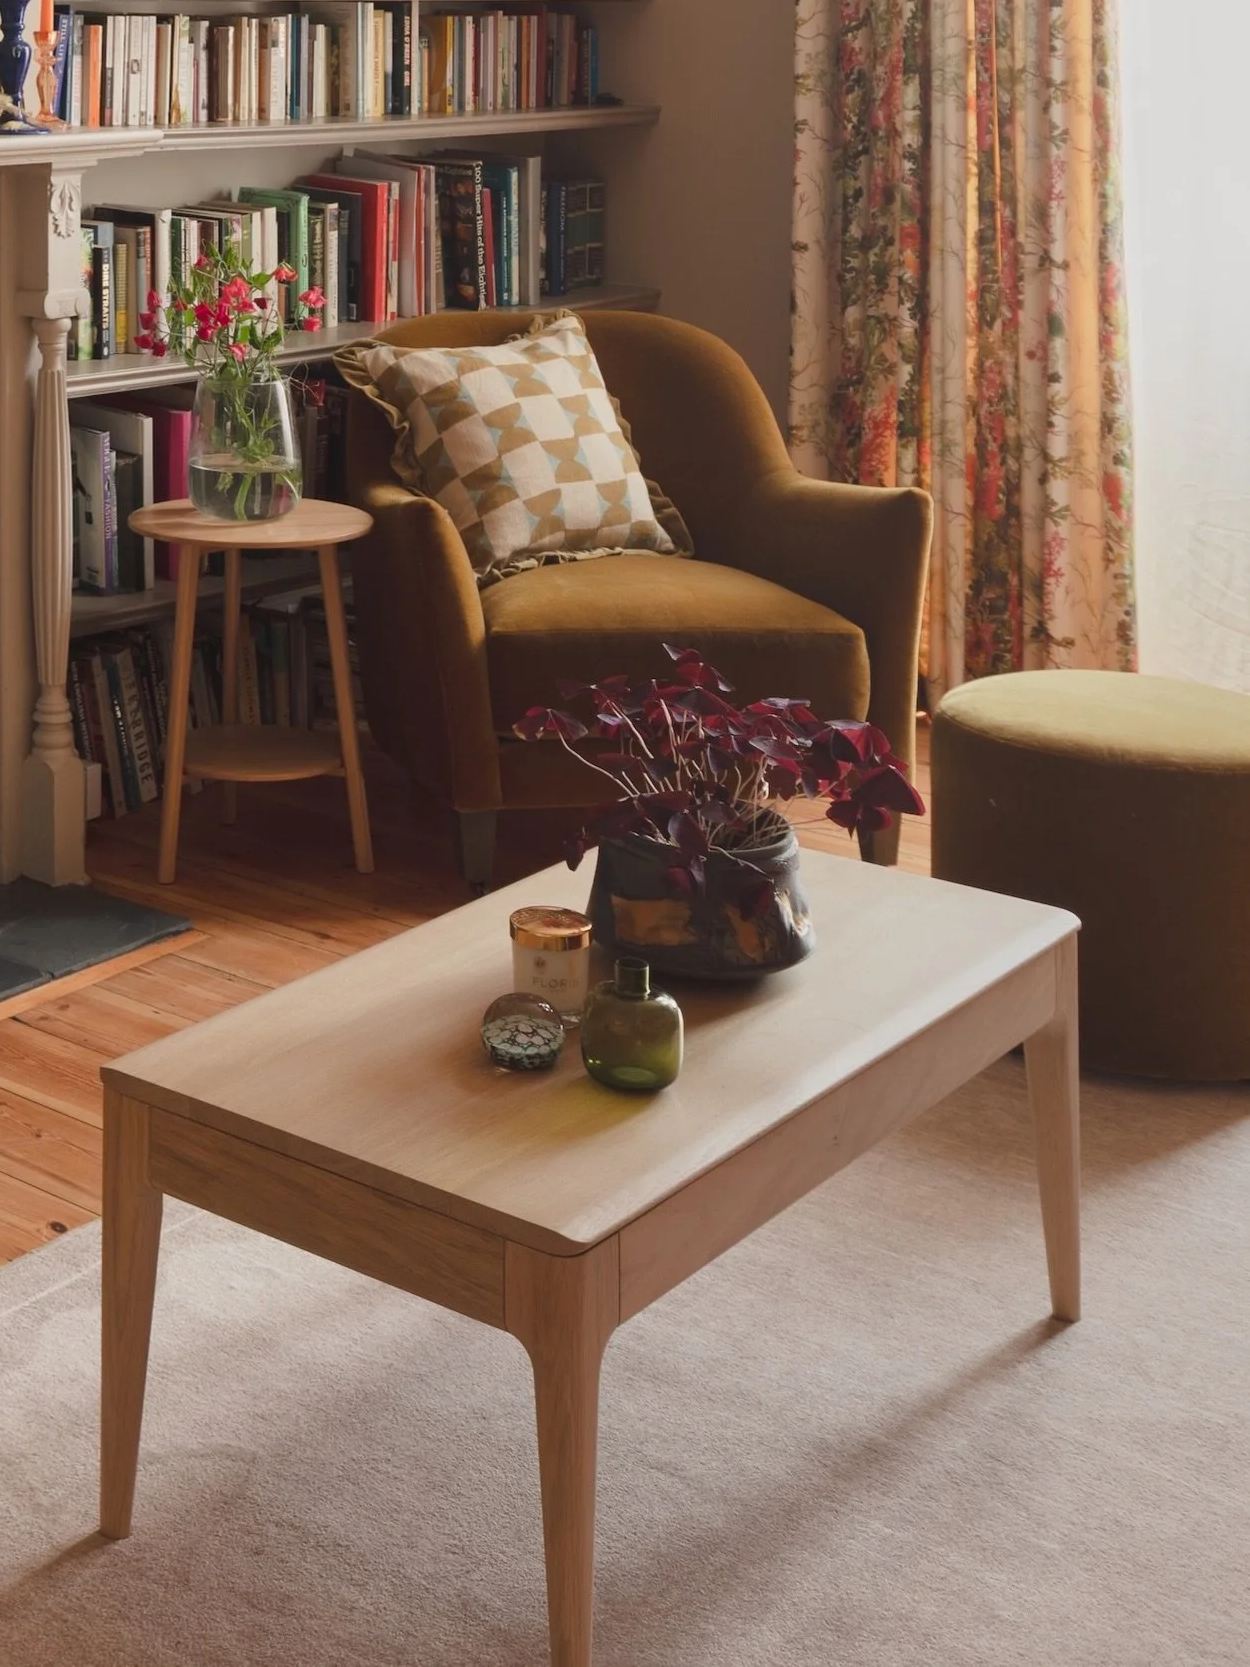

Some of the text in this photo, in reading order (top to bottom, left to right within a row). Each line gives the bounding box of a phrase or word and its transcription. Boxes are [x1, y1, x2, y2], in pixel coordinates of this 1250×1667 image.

[475, 166, 483, 183] 100
[475, 184, 484, 214] Super
[560, 186, 568, 232] FREEDOM
[476, 215, 485, 235] Hits
[477, 236, 485, 246] of
[477, 246, 486, 264] the
[102, 263, 110, 329] DIRE STRAITS
